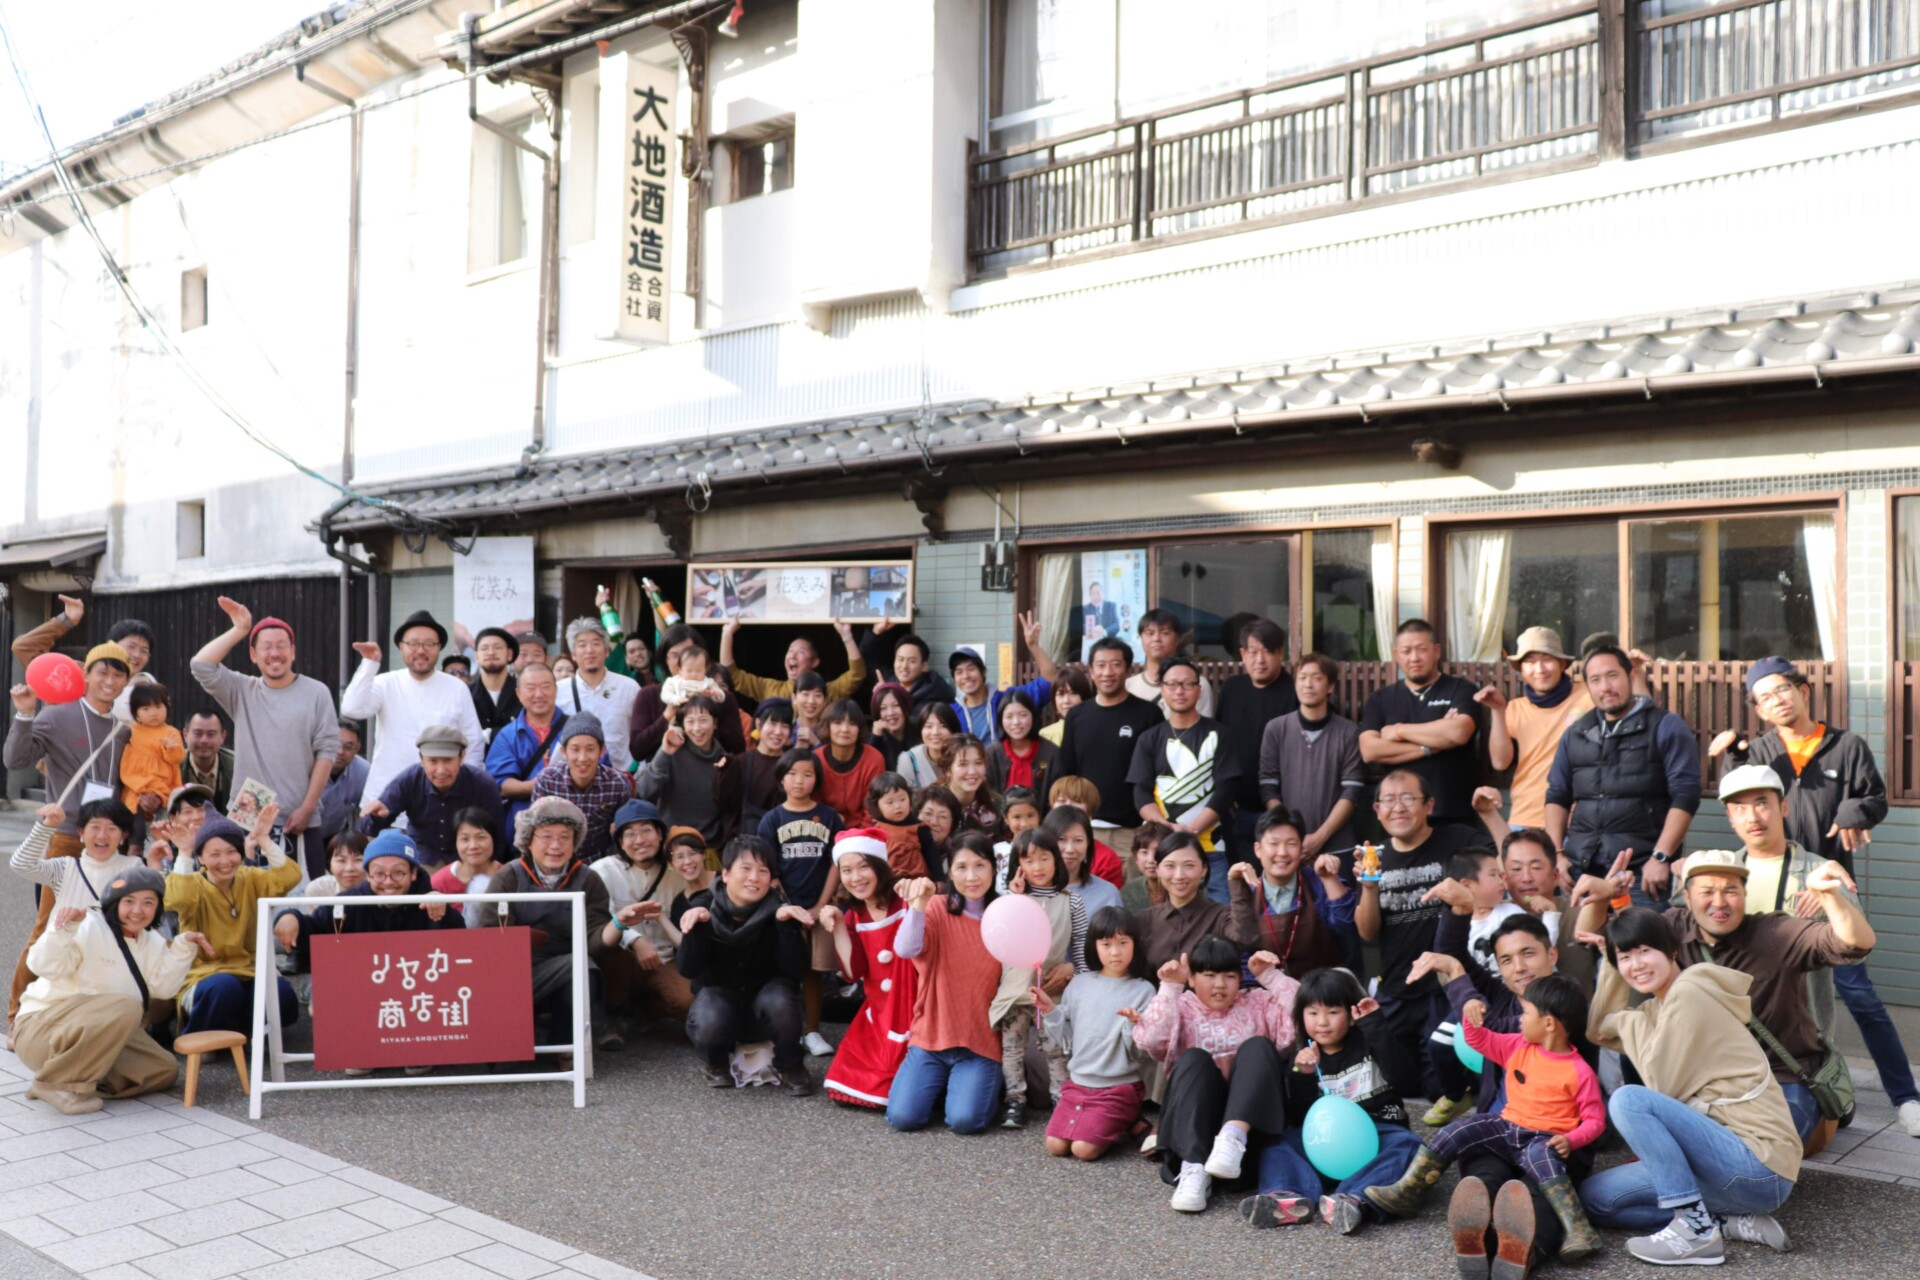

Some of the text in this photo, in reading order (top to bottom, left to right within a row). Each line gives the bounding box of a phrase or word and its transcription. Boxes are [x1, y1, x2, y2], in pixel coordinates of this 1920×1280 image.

[628, 86, 669, 273] 大地酒造
[625, 271, 643, 318] 会社
[646, 275, 663, 322] 合資
[469, 575, 518, 601] 花笑み
[773, 575, 827, 594] 花笑み
[782, 841, 825, 859] STREET
[371, 948, 473, 990] リヤカー
[377, 986, 472, 1029] 商店街
[380, 1033, 469, 1044] RIYAKA-SHOUTENGAI
